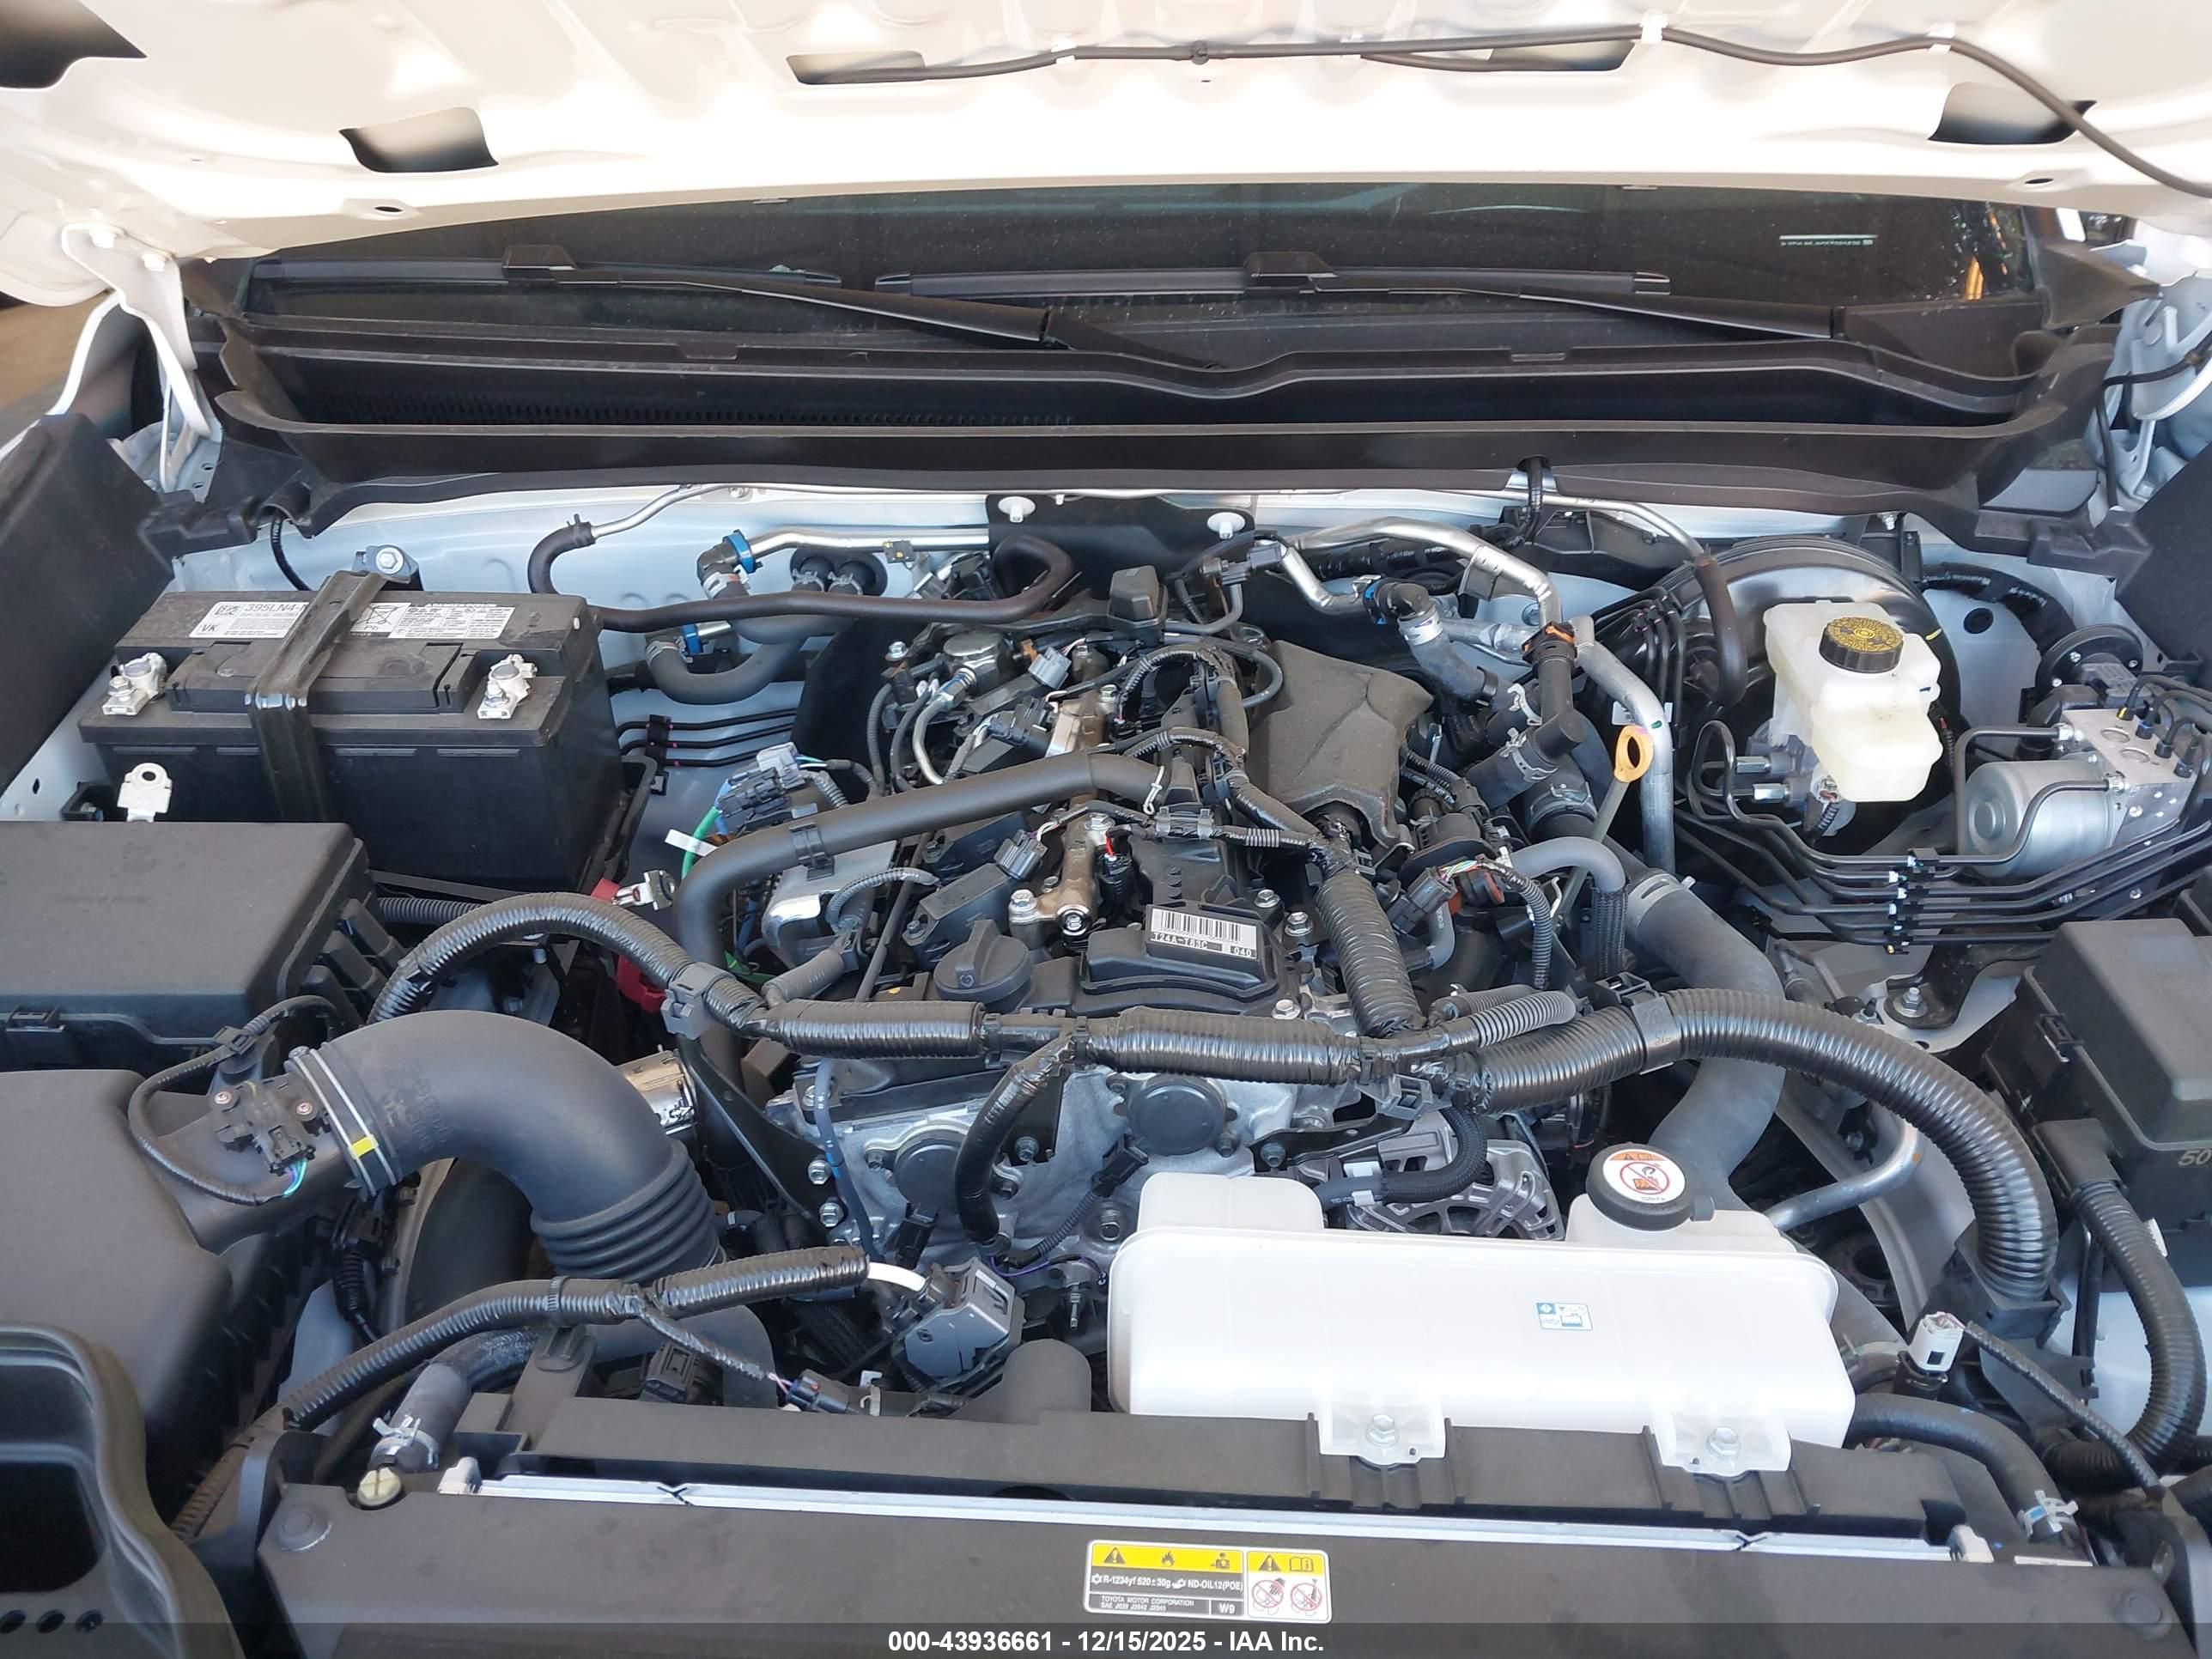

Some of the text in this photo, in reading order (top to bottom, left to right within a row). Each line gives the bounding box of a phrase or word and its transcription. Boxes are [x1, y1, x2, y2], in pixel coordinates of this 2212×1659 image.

[1103, 1574, 1137, 1586] R-1234yf
[1101, 1595, 1194, 1607] TOYOTA MOTOR CORPORATION
[1219, 1603, 1236, 1615] W9
